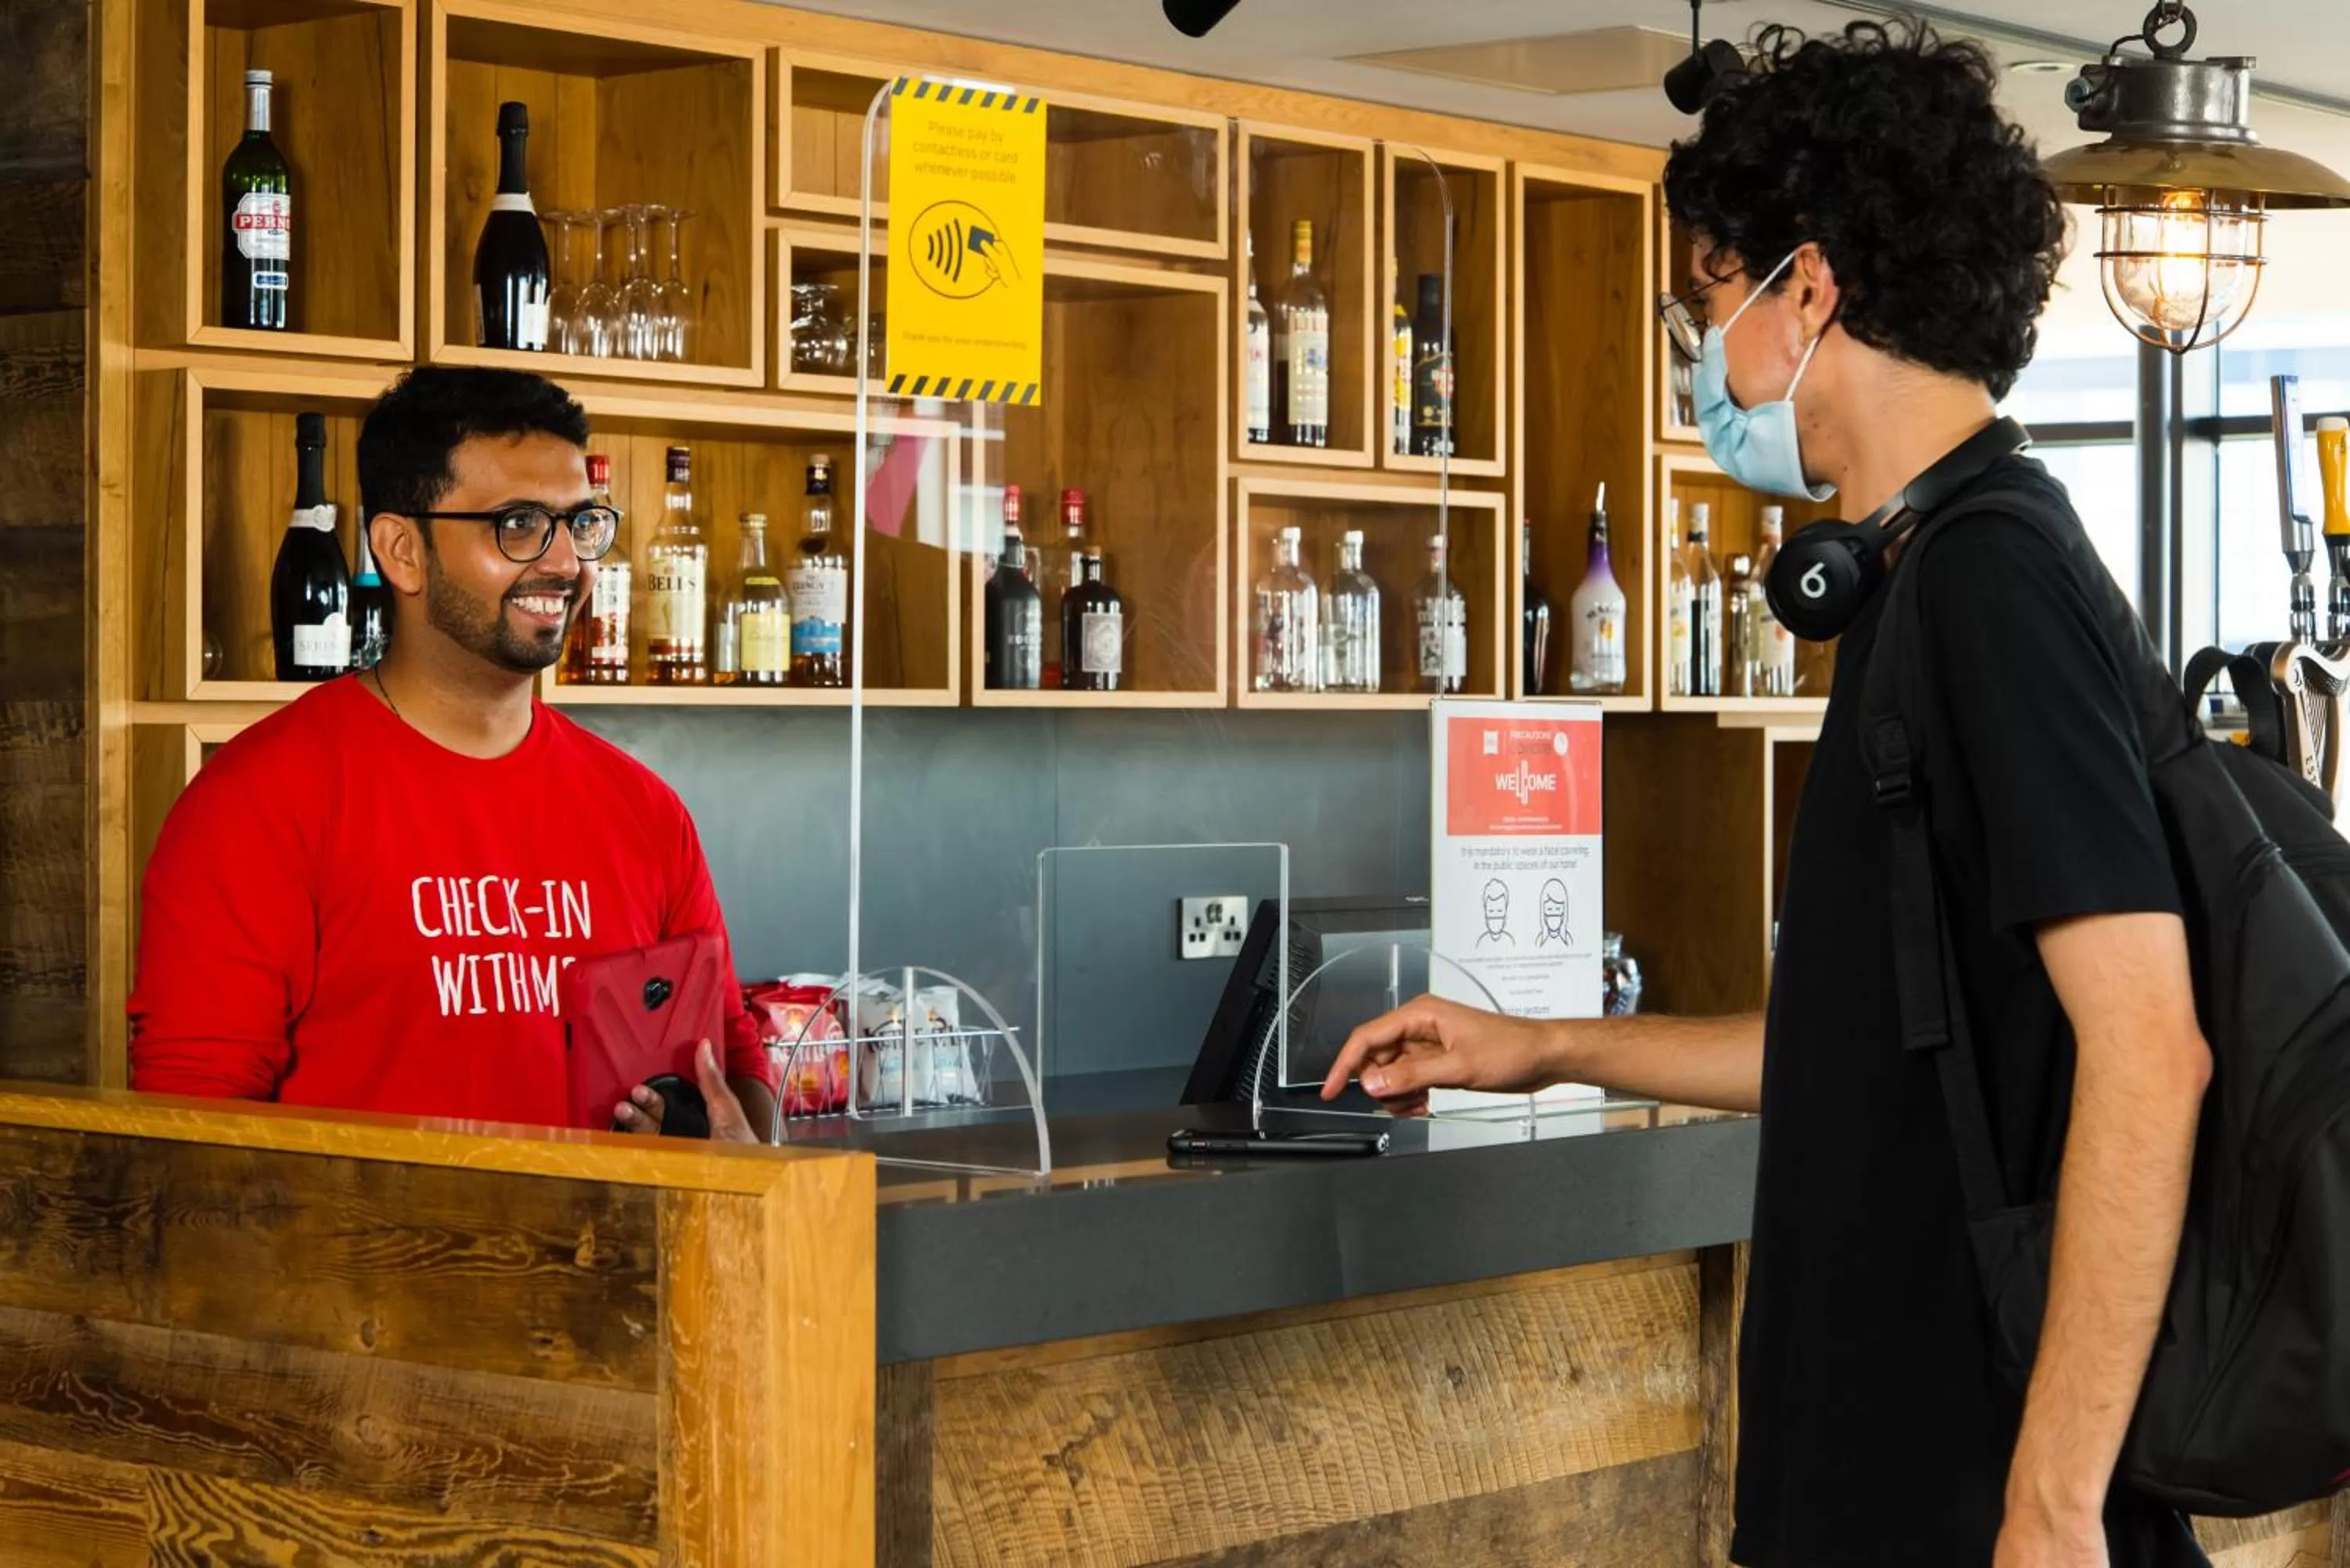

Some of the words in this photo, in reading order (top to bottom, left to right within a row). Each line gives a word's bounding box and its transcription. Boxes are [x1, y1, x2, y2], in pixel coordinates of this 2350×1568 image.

[648, 573, 696, 591] BELLS
[411, 875, 591, 940] CHECK-IN
[432, 952, 576, 1017] WITHM
